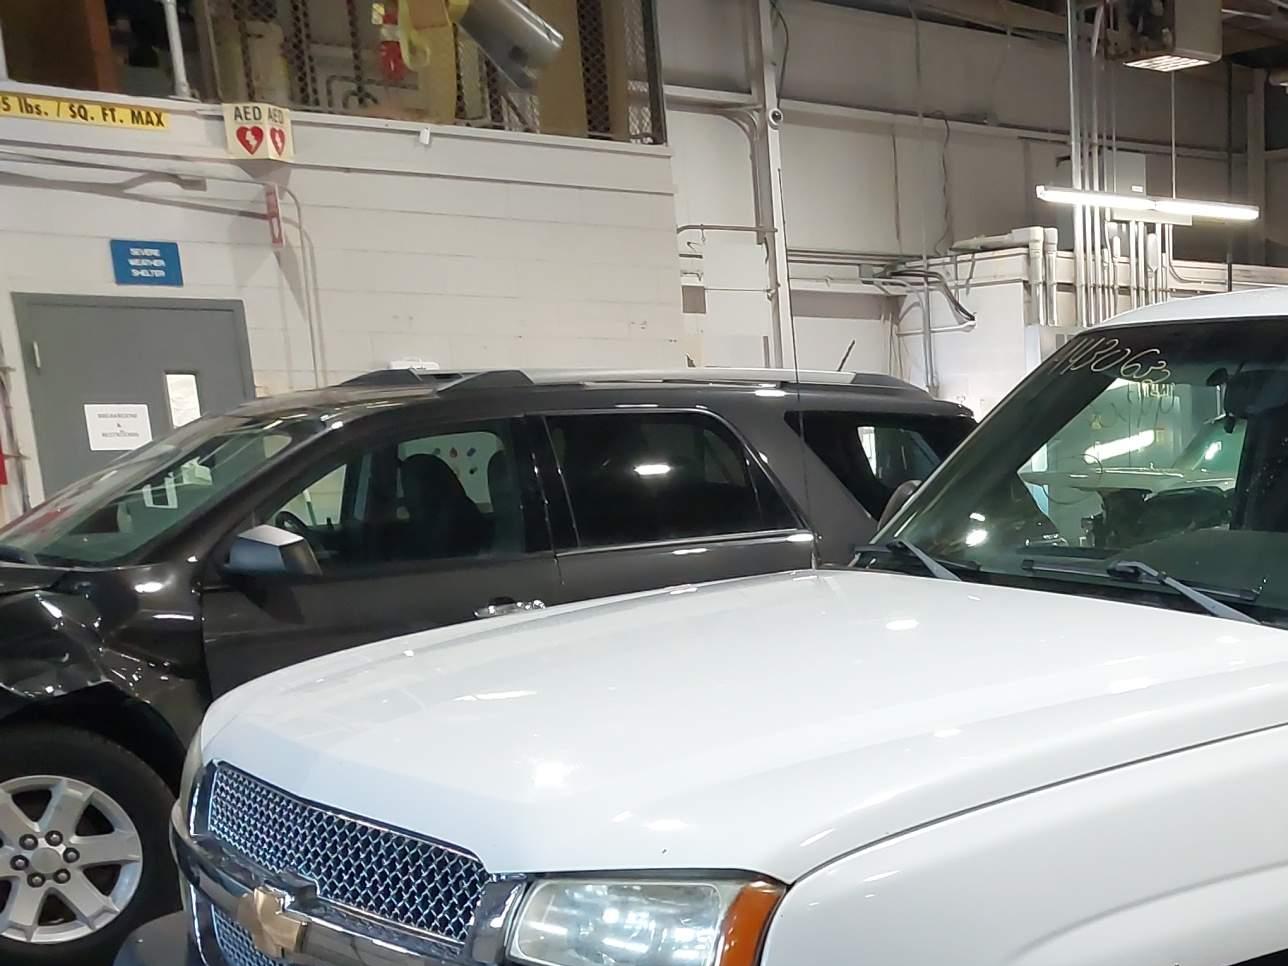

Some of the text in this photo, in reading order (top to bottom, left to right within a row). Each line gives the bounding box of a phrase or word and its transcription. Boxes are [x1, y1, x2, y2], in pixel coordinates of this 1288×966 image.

[17, 97, 49, 116] lbs.
[56, 101, 61, 117] /
[68, 103, 95, 122] SQ.
[101, 107, 124, 124] FT.
[131, 109, 165, 128] MAX
[234, 106, 262, 121] AED
[268, 107, 284, 124] AED
